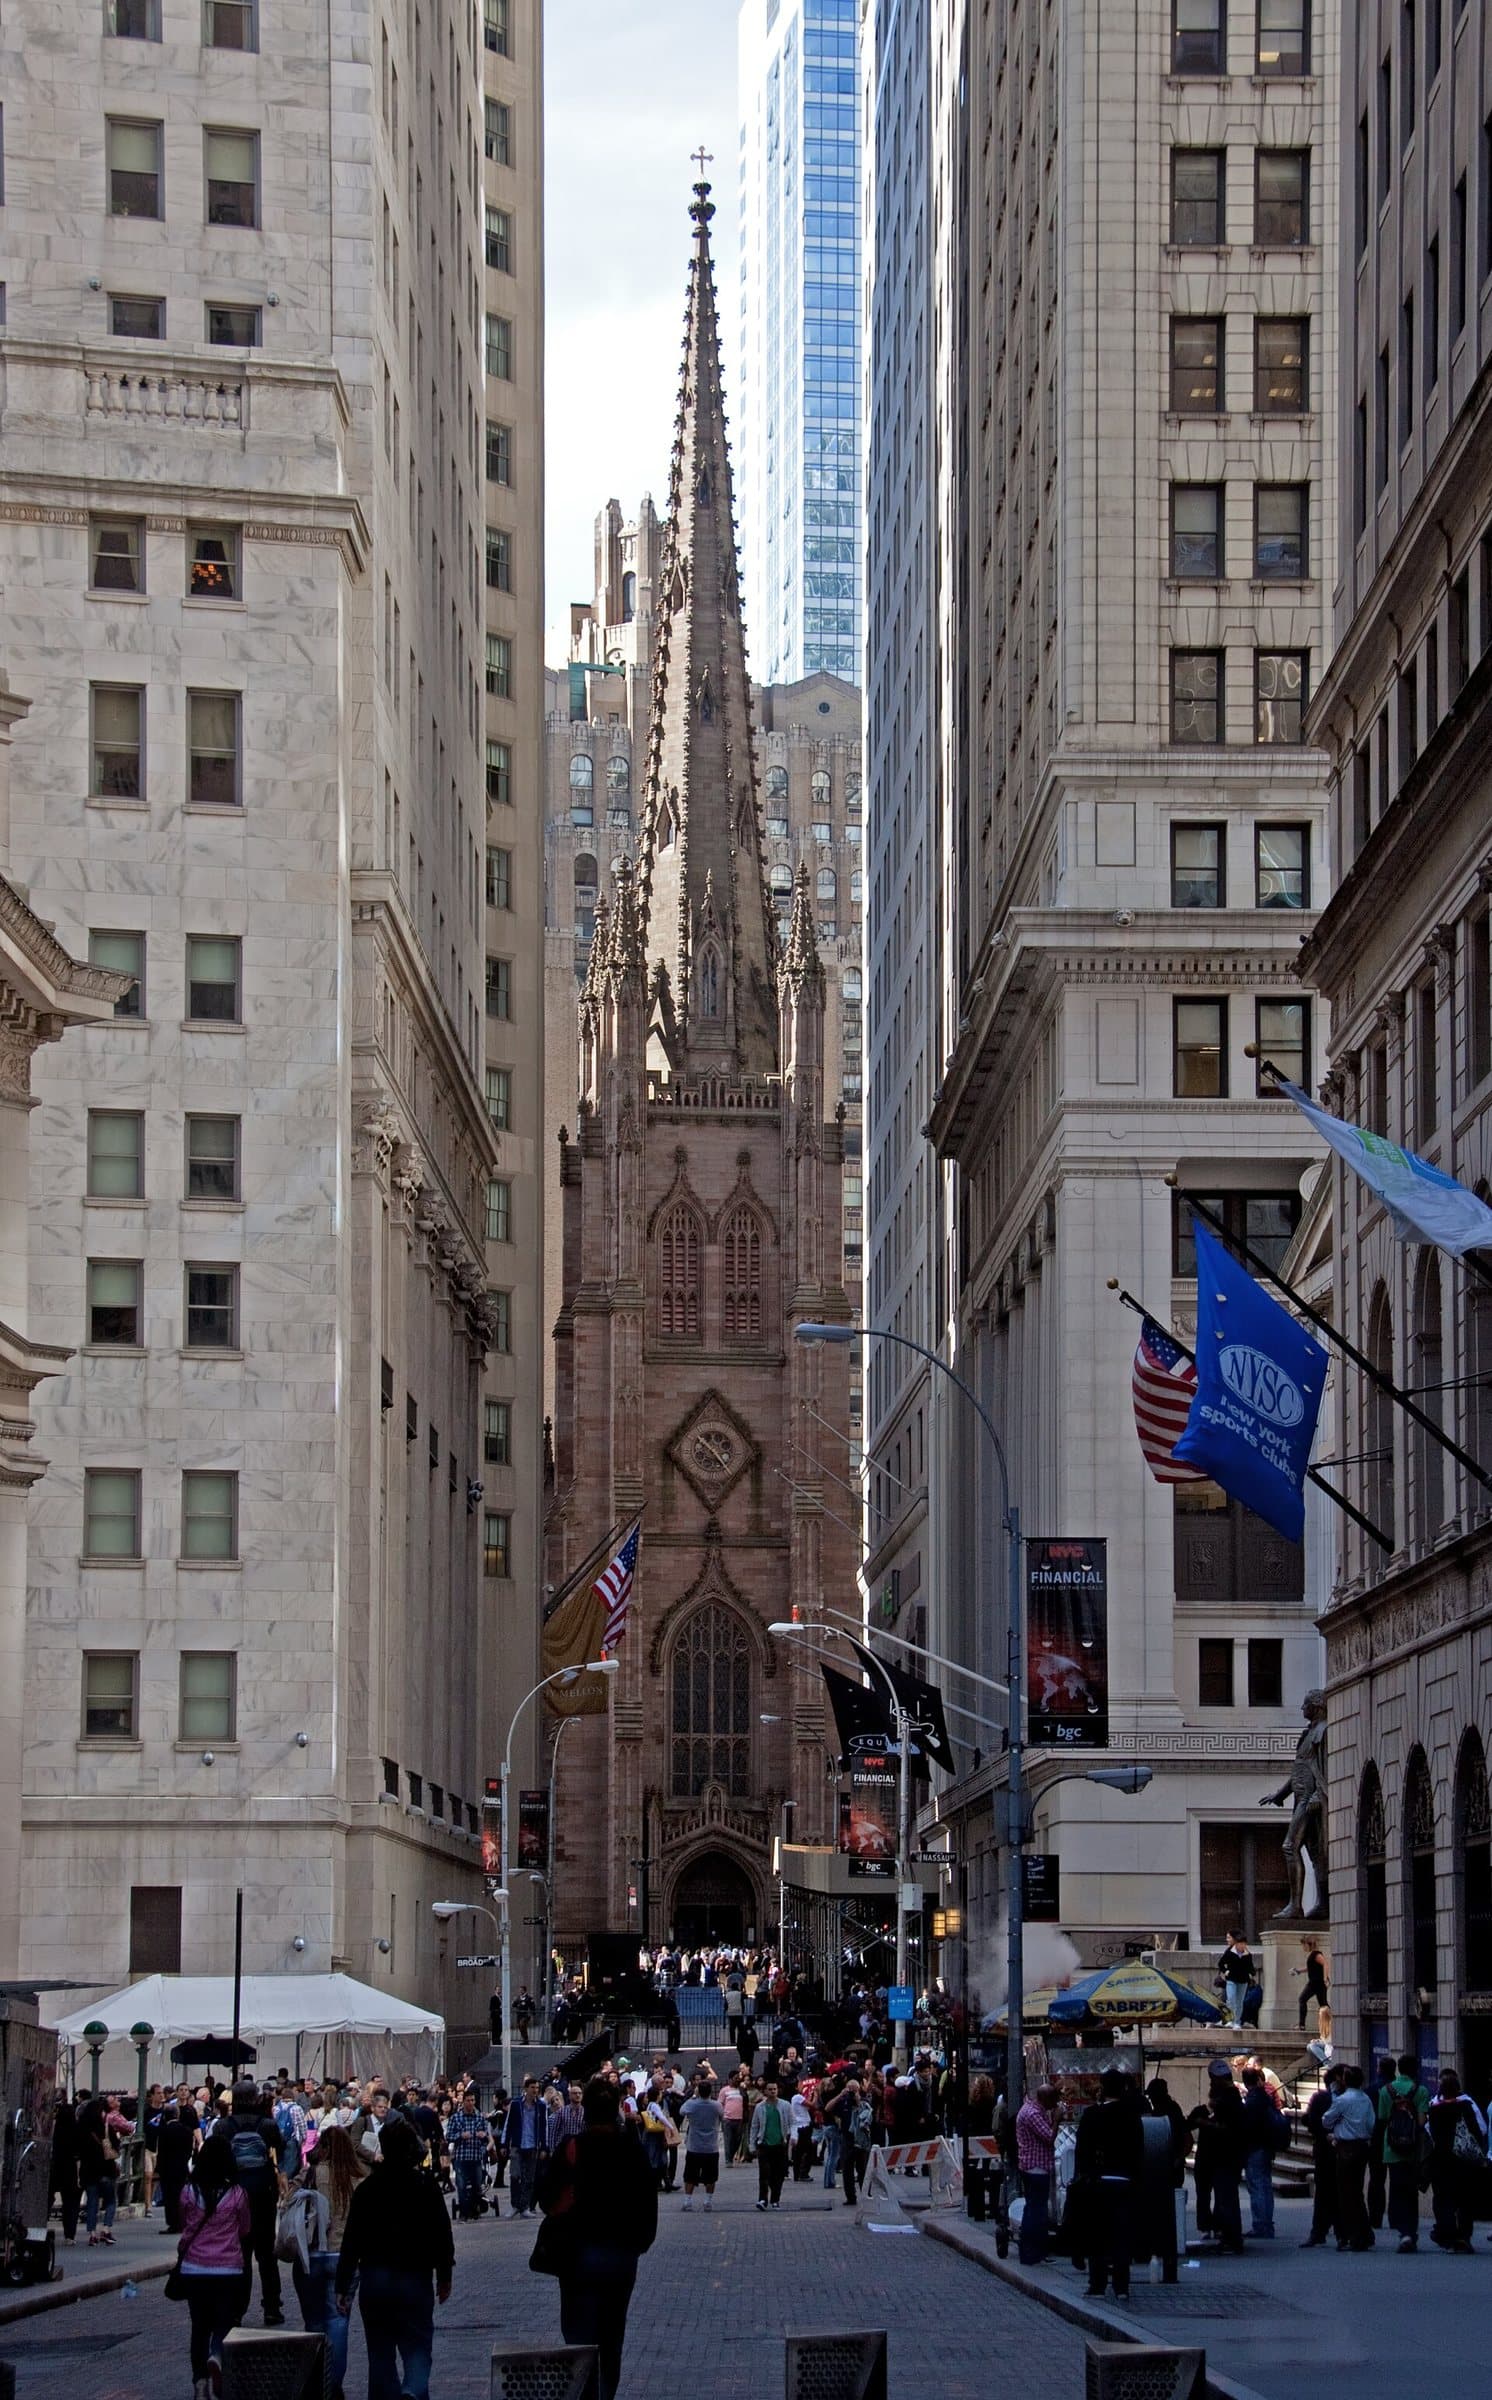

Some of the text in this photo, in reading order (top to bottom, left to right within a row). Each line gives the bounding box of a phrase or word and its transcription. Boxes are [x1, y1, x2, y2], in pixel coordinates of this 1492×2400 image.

[1228, 1350, 1295, 1420] NYSC
[1199, 1404, 1298, 1486] sports clubs
[1258, 1422, 1293, 1457] york
[1048, 1544, 1085, 1558] NYC
[1031, 1571, 1104, 1584] FINANCIAL
[1056, 1723, 1082, 1741] bgc
[863, 1757, 885, 1766] NYC
[853, 1773, 896, 1783] FINANCIAL
[922, 1853, 950, 1862] NASSAU
[865, 1860, 882, 1872] bgc
[457, 1959, 484, 1967] BROAD
[1095, 2000, 1171, 2014] SABRETT
